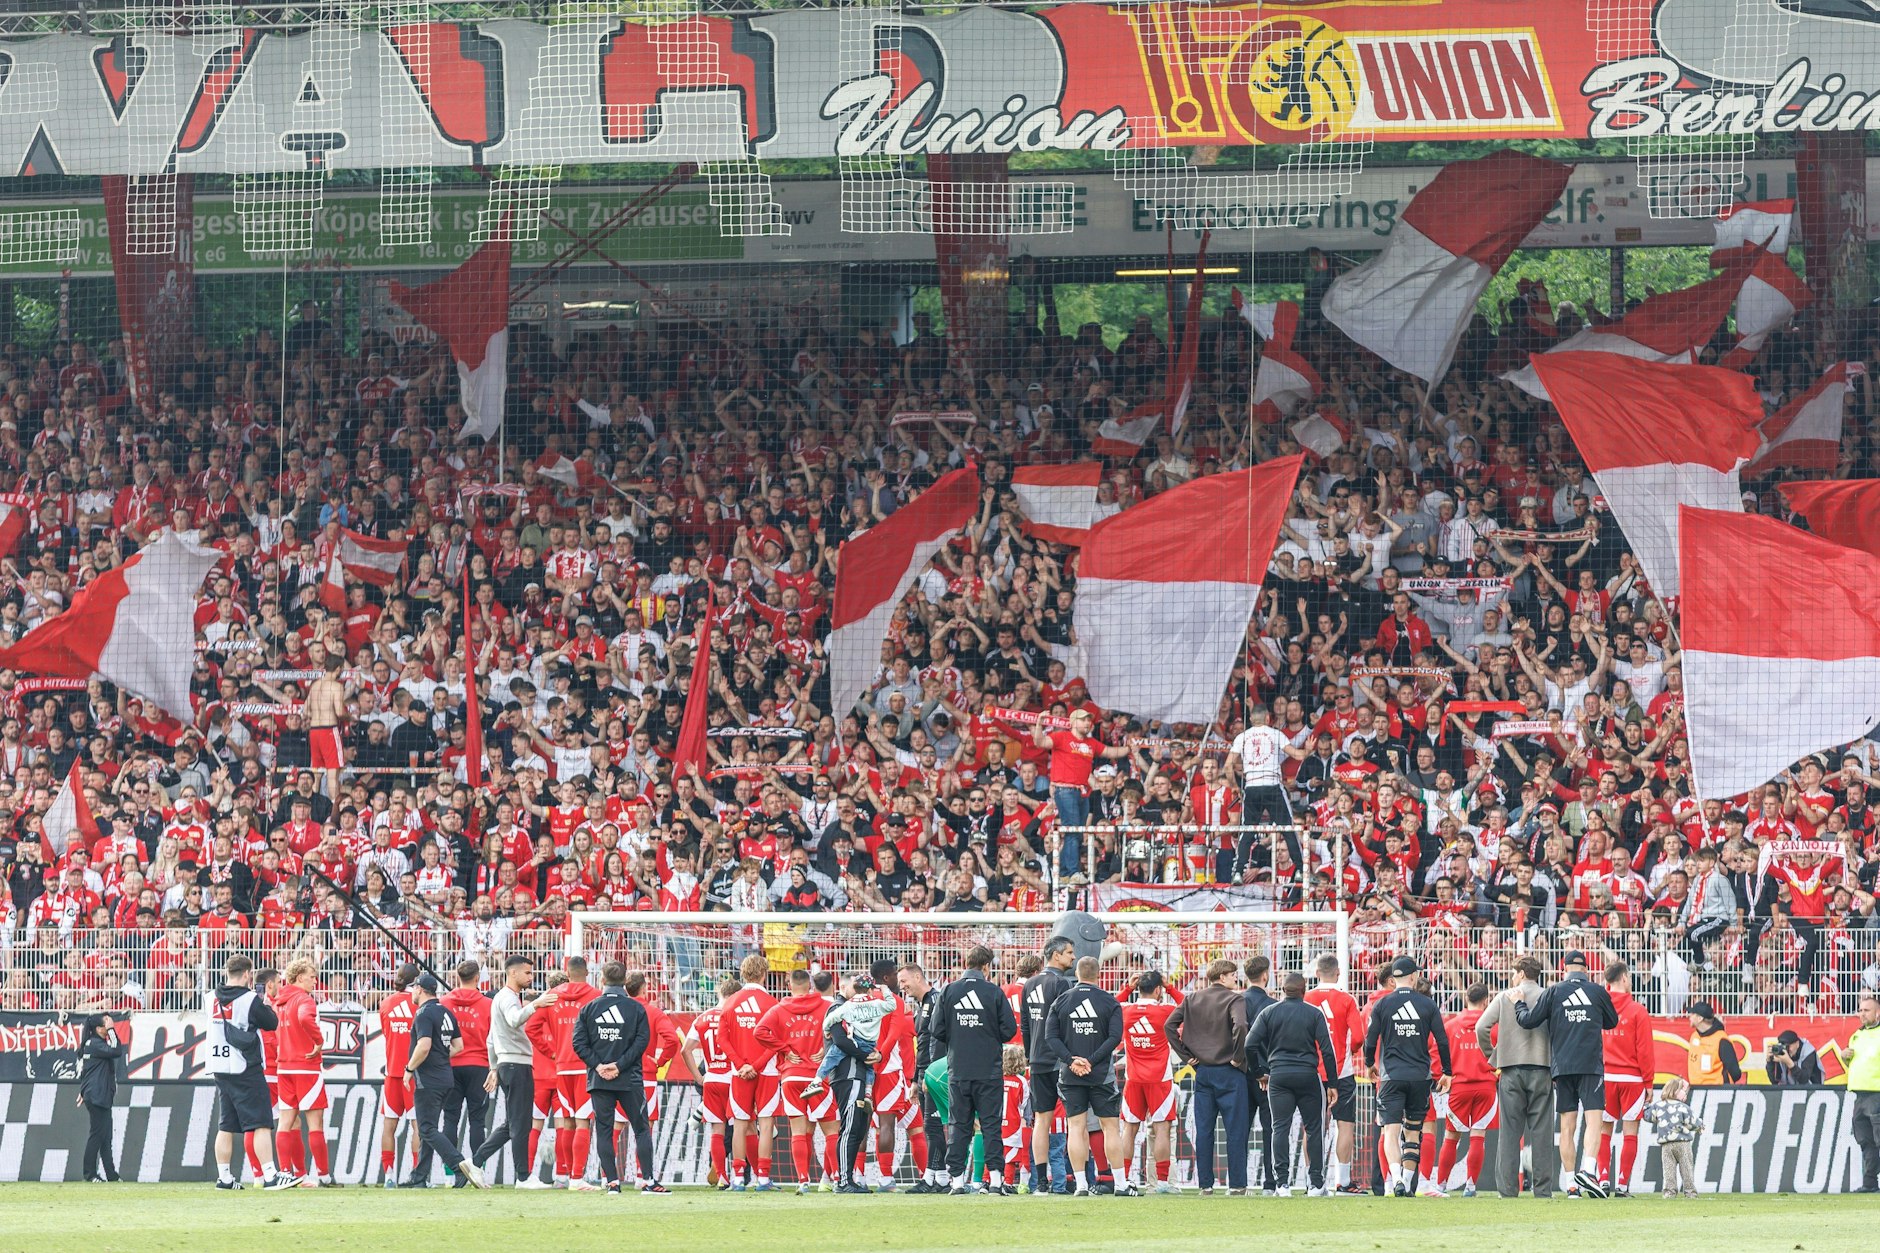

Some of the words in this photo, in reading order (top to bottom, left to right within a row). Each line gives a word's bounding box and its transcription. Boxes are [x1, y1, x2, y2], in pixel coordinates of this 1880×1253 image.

[1356, 38, 1552, 122] UNION
[820, 73, 1134, 156] Union
[1580, 56, 1880, 139] Berlin
[44, 679, 87, 688] MITGLIED
[1020, 712, 1050, 724] Unin
[957, 1012, 979, 1020] home
[1565, 1008, 1587, 1017] home
[960, 1018, 968, 1026] to
[1568, 1014, 1576, 1022] to
[1073, 1020, 1094, 1028] home
[1394, 1022, 1416, 1030] home
[598, 1026, 620, 1034] home
[1075, 1026, 1083, 1034] to
[1397, 1028, 1405, 1036] to
[600, 1032, 608, 1040] to
[212, 1045, 230, 1058] 18
[1766, 1089, 1863, 1194] FOR
